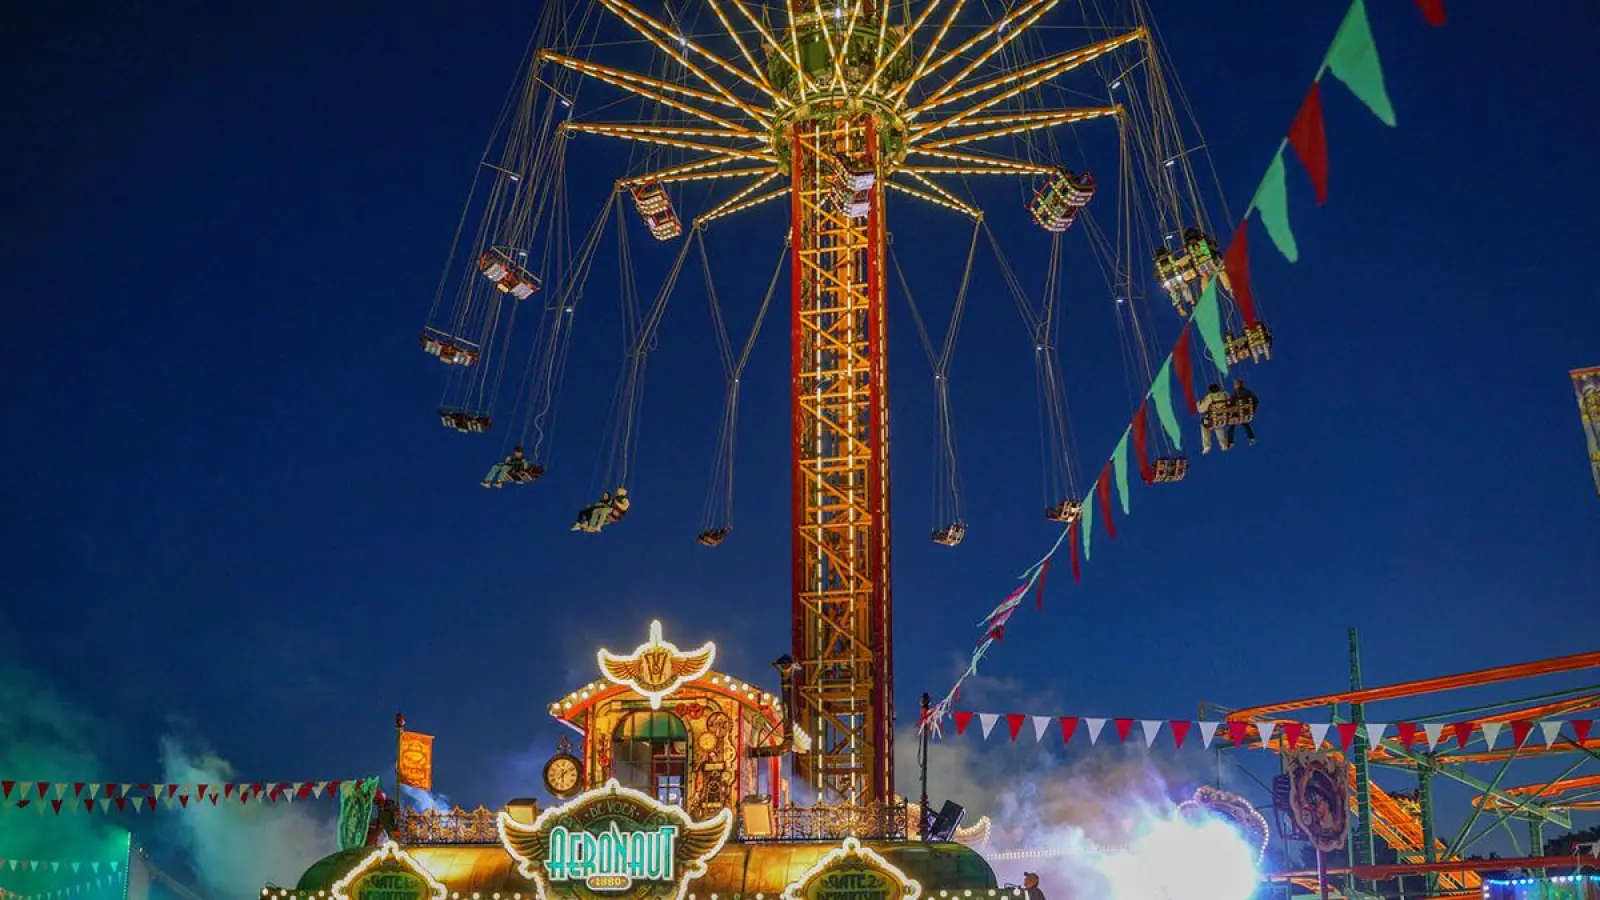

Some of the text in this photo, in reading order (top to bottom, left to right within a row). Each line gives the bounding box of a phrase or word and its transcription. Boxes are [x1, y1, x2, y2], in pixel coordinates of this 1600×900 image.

[546, 822, 677, 880] AERONAUT
[594, 876, 623, 887] 1880
[828, 874, 865, 889] GATE
